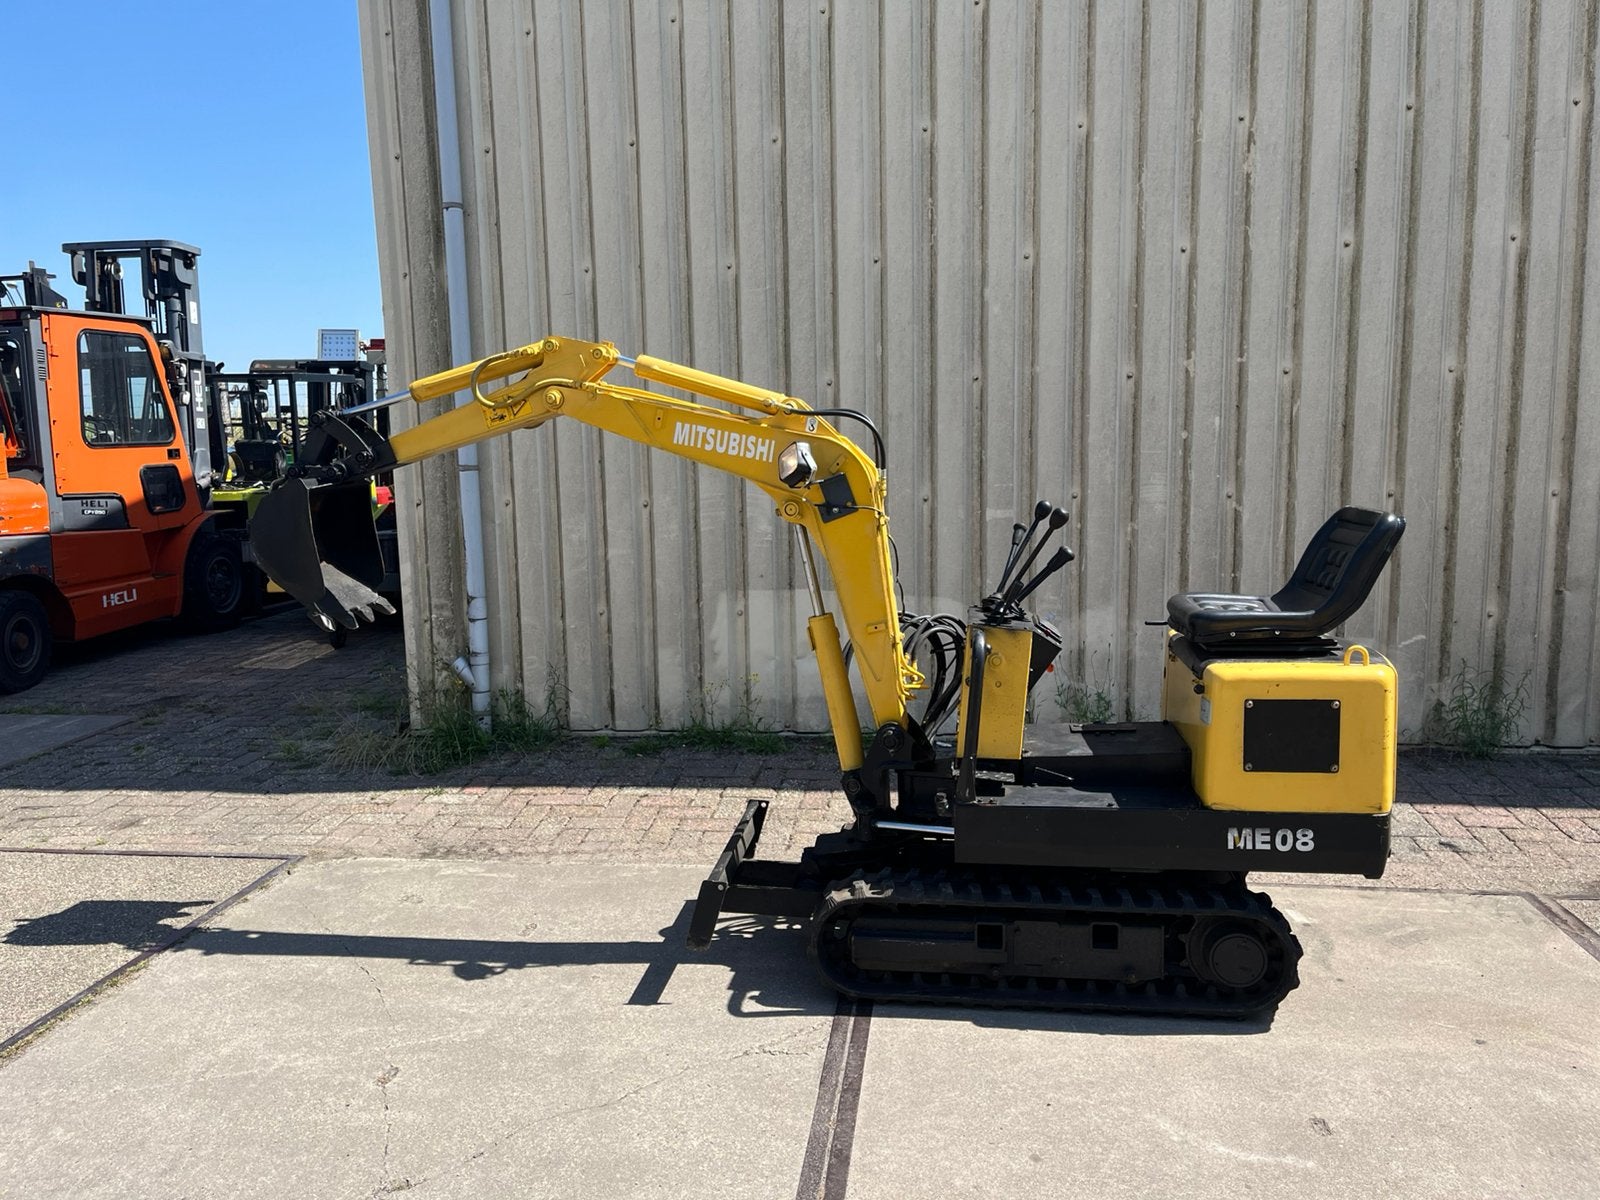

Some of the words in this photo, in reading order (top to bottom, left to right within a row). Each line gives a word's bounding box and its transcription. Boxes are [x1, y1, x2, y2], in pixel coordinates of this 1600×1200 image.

[193, 370, 204, 412] HELI
[674, 422, 776, 463] MITSUBISHI
[81, 500, 109, 508] HELI
[102, 588, 137, 608] HELI
